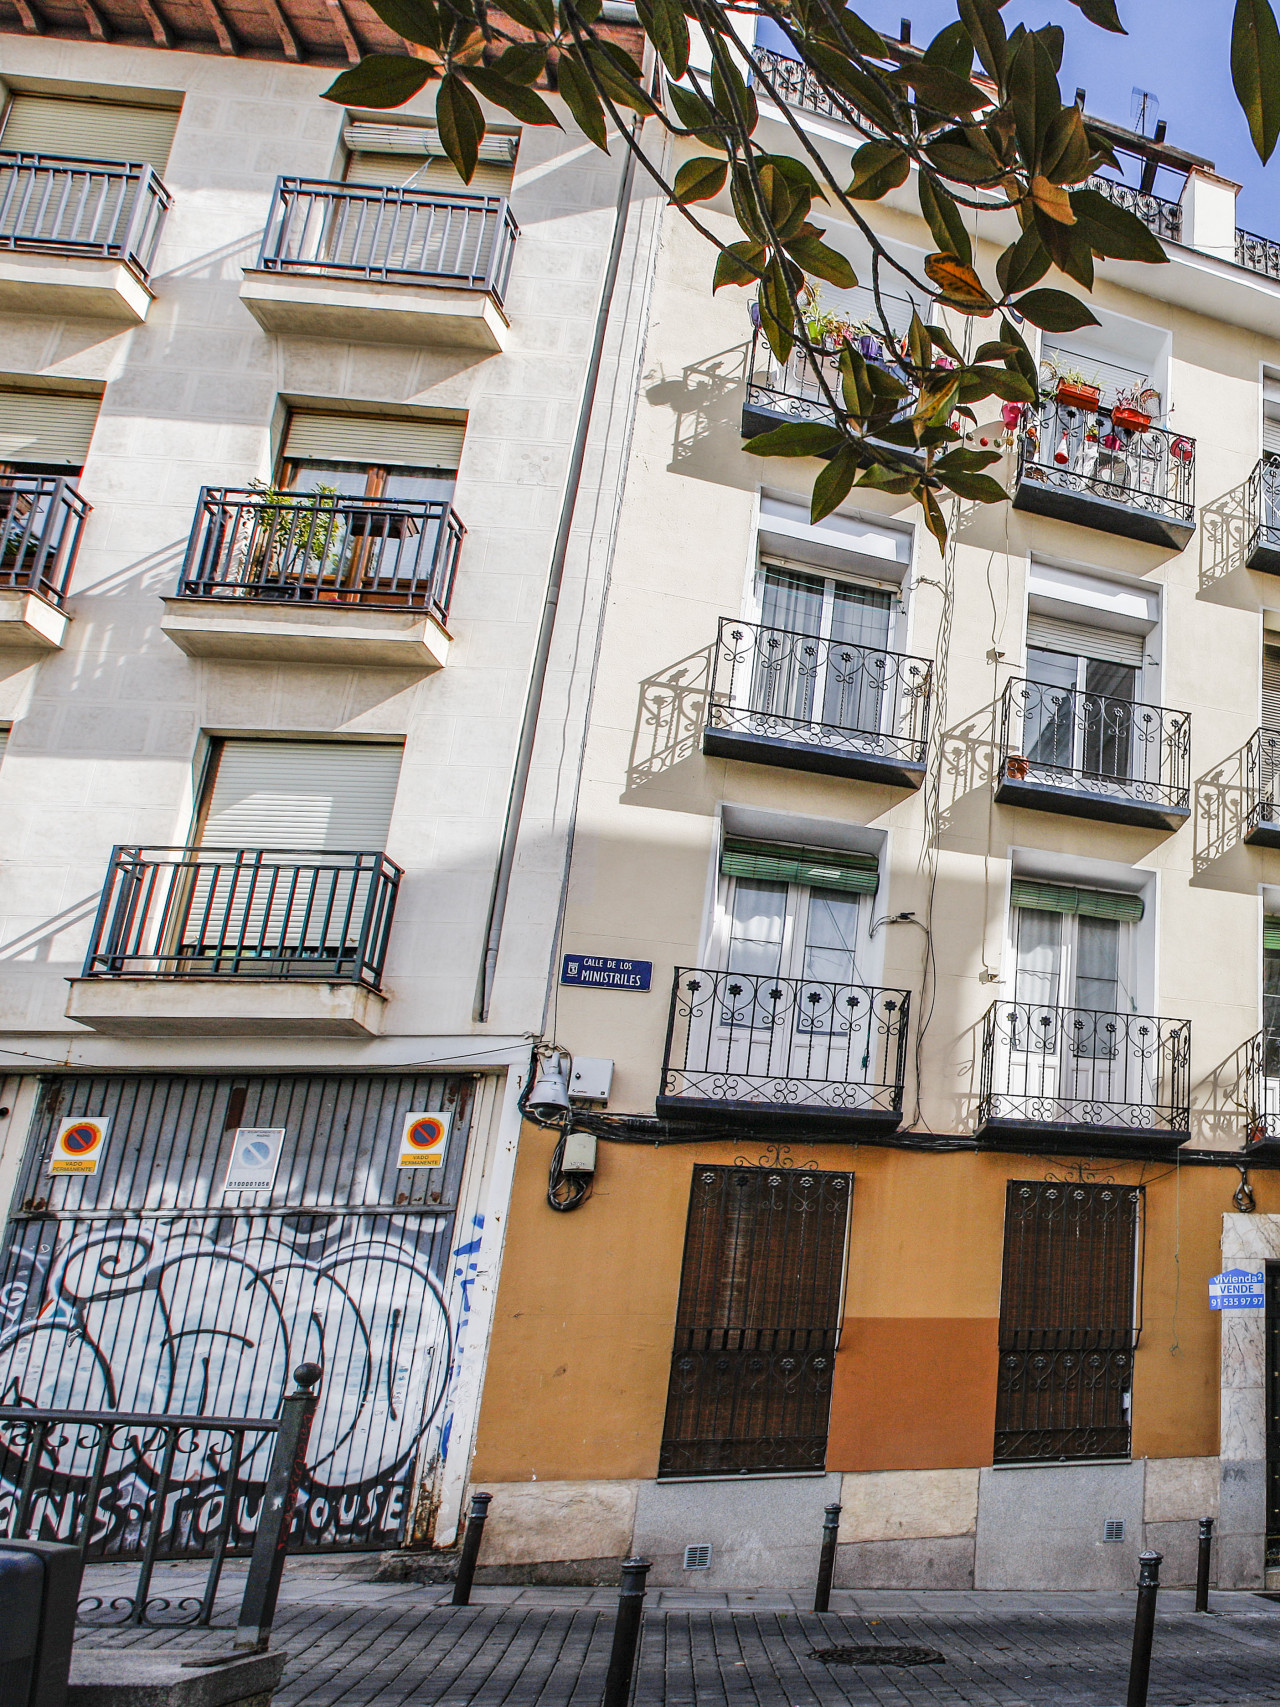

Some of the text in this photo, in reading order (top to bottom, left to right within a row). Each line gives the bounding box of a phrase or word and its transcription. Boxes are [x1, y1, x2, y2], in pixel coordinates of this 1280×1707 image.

[583, 958, 633, 971] CALLE DE LOS
[581, 970, 641, 986] MINISTRILES
[1220, 1284, 1254, 1294] VENDE
[1211, 1296, 1263, 1307] 91 535 97 97
